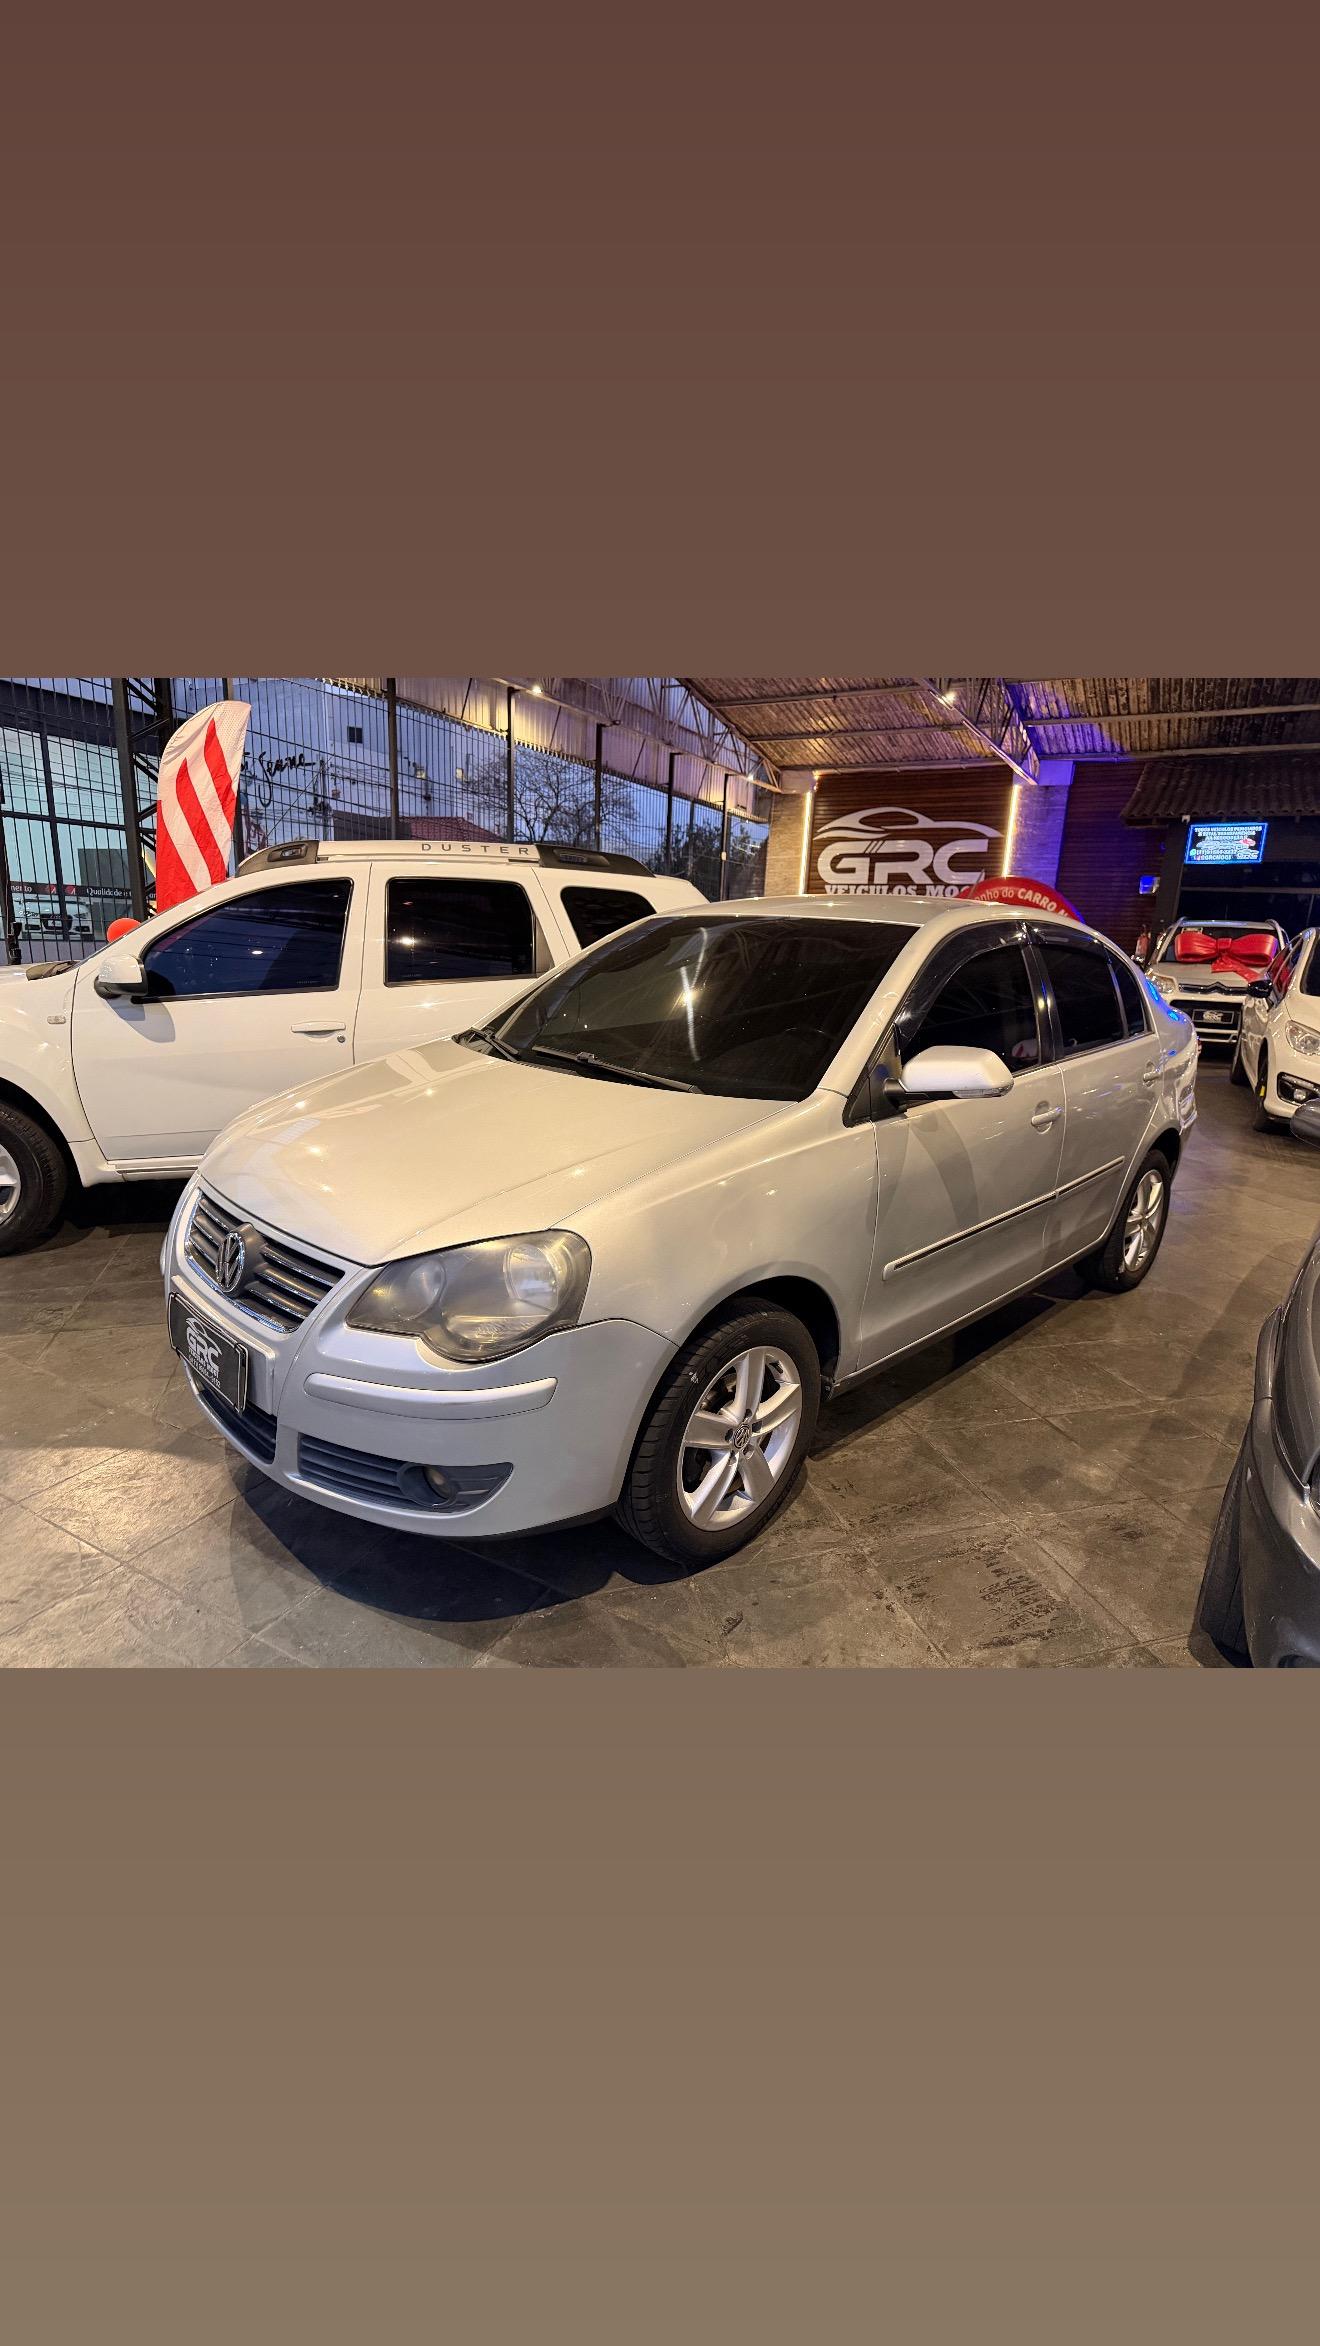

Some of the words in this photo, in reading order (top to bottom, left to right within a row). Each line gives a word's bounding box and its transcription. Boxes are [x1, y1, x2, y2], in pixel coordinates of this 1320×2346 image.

[421, 843, 529, 856] DUSTER
[817, 839, 989, 885] GRC
[925, 885, 971, 898] MO
[1001, 887, 1014, 899] do
[1017, 887, 1058, 912] CARRO
[186, 1326, 220, 1372] GRC
